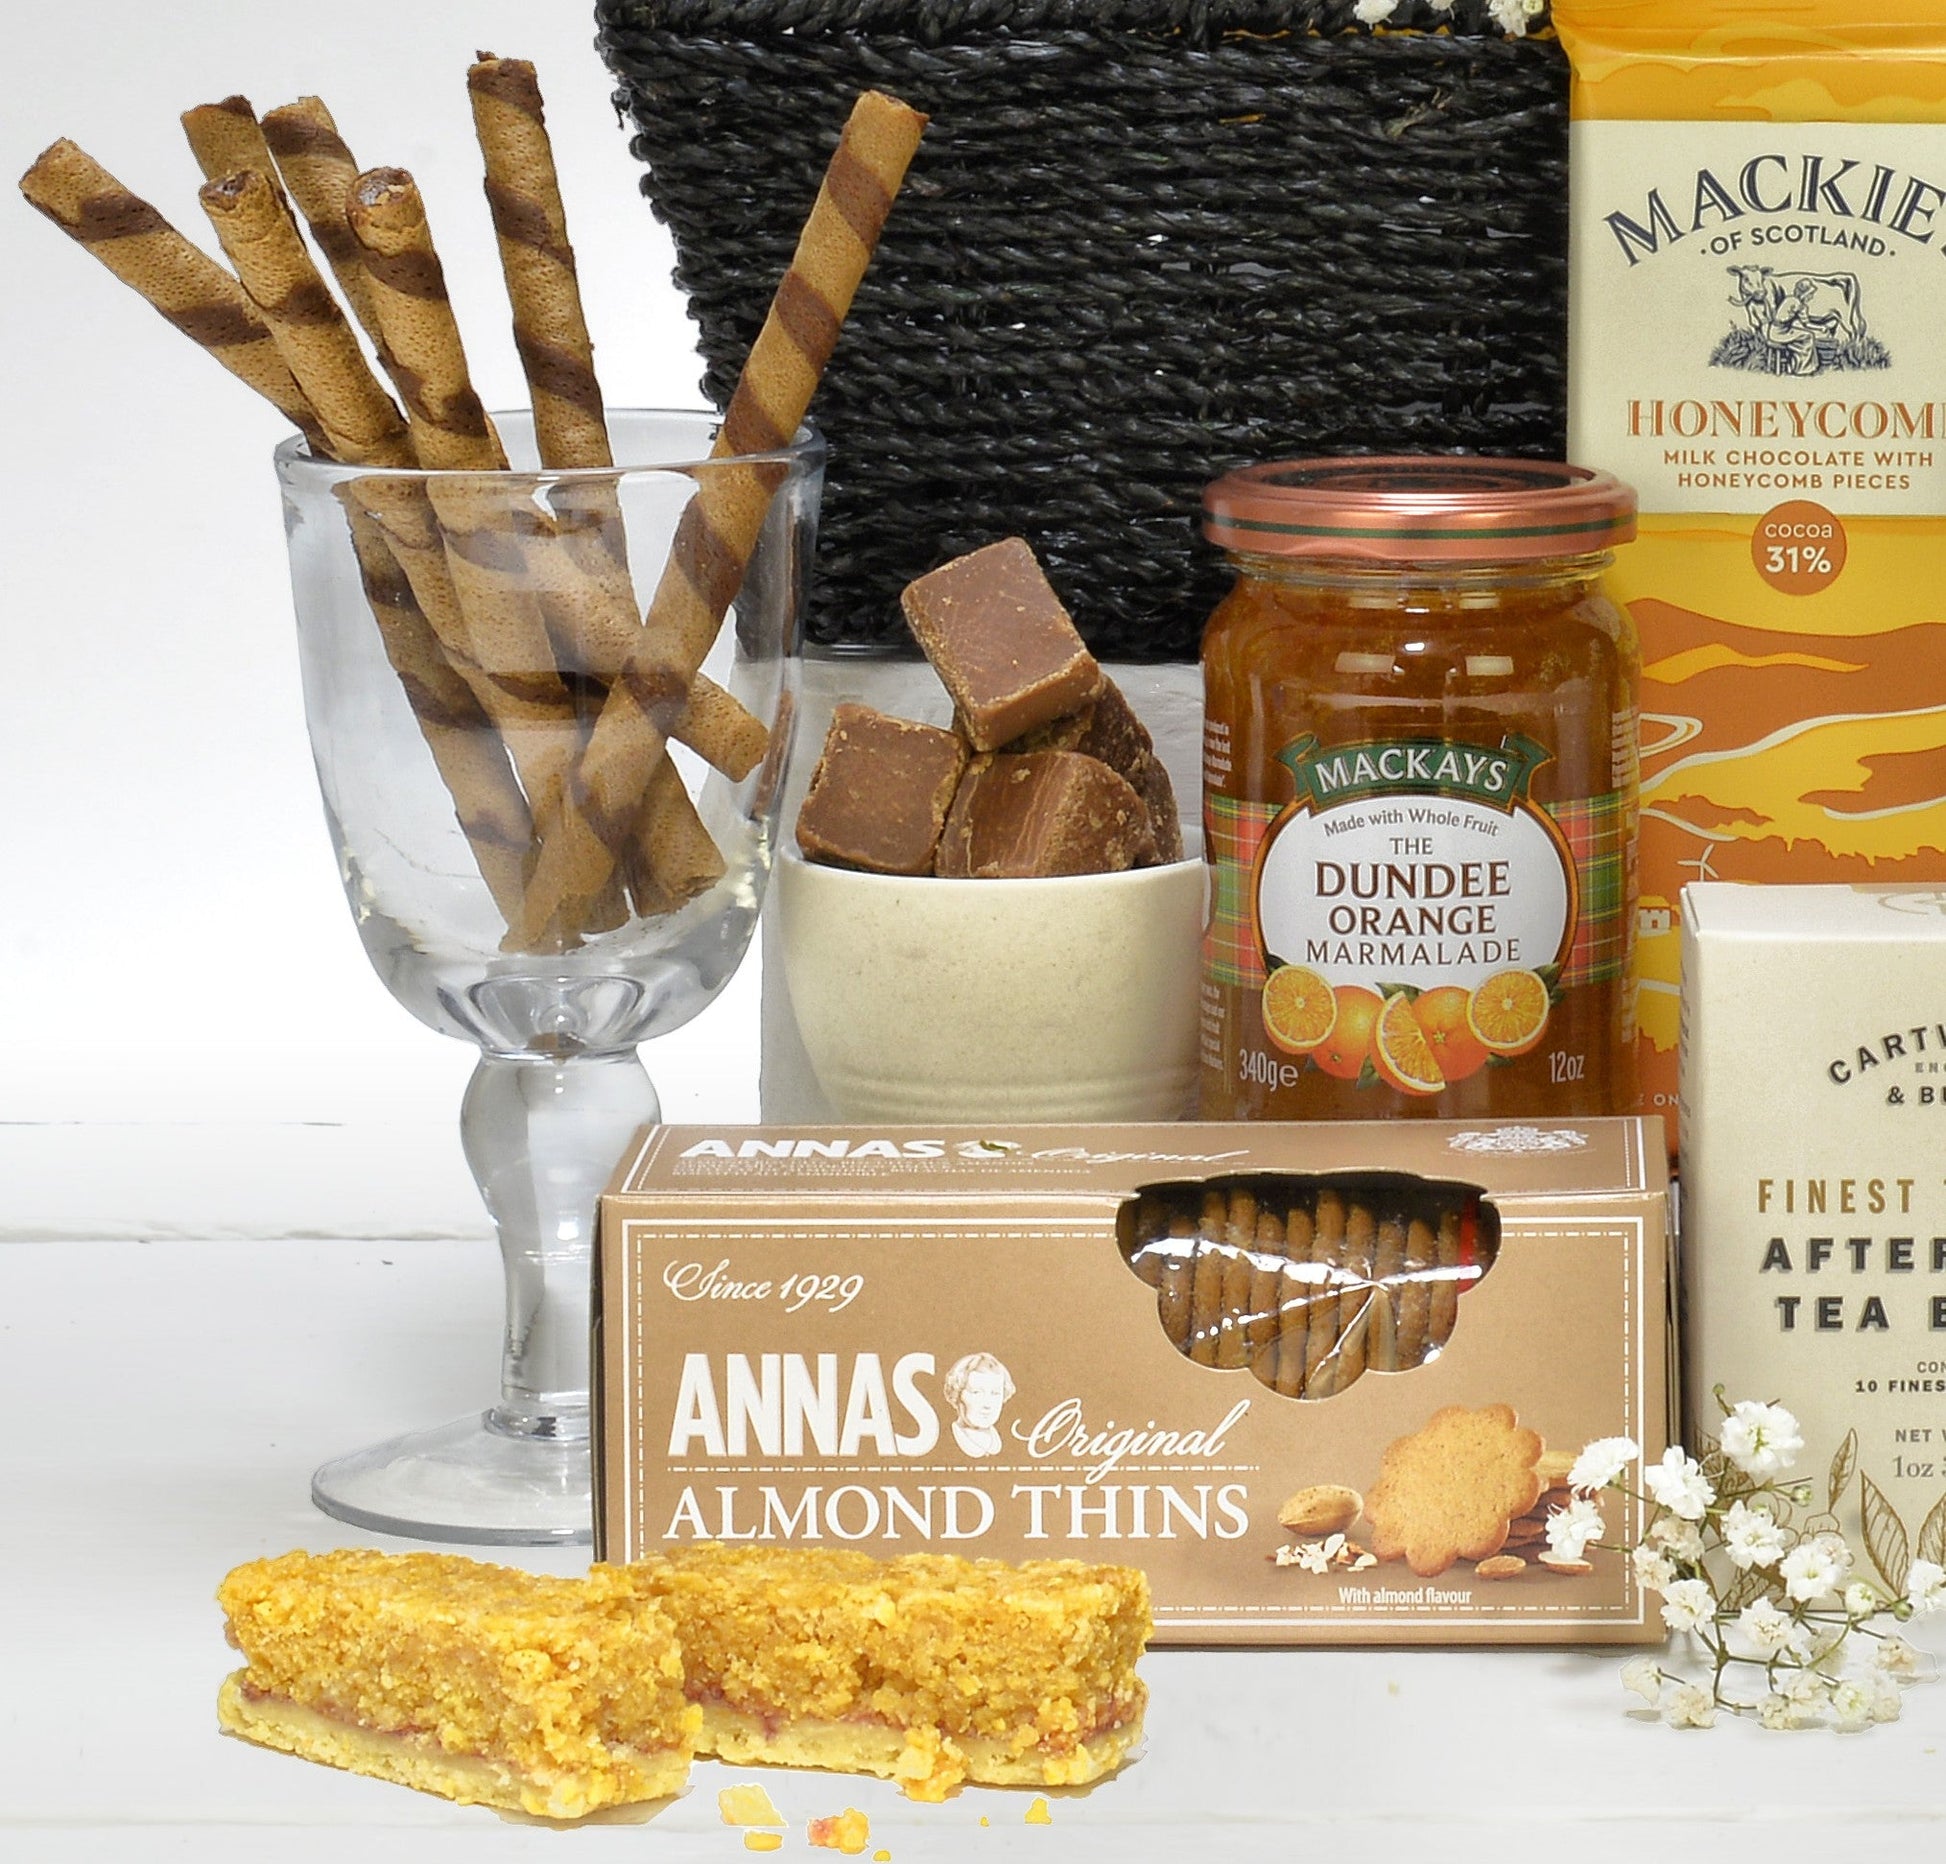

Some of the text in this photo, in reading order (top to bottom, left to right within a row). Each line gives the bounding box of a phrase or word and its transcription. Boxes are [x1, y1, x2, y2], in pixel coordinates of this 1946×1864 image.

[1603, 154, 1946, 266] MACKIE
[1627, 400, 1946, 438] HONEYCOM
[1664, 450, 1932, 467] MILK CHOCOLATE WITH
[1678, 473, 1910, 490] HONEYCOMB PIECES
[1765, 523, 1833, 539] cocoa
[1765, 545, 1832, 573] 31%
[1313, 748, 1508, 794] MACKAYS
[1324, 809, 1499, 837] Made with Whole Fruit
[1390, 837, 1433, 855] THE
[1315, 861, 1511, 898] DUNDEE
[1329, 905, 1497, 936] ORANGE
[1307, 939, 1522, 965] MARMALADE
[1549, 1050, 1585, 1083] 12oz
[1886, 1085, 1905, 1105] &
[680, 1139, 945, 1158] ANNAS
[1758, 1178, 1914, 1214] FINEST
[662, 1258, 864, 1313] Since 1929
[1775, 1295, 1890, 1333] TEA
[1855, 1380, 1878, 1393] 10
[668, 1352, 1250, 1484] ANNAS Original
[1895, 1429, 1932, 1442] NET
[1892, 1455, 1934, 1478] 1oz
[662, 1484, 1249, 1540] ALMOND THINS
[1338, 1586, 1472, 1605] With almond flavour
